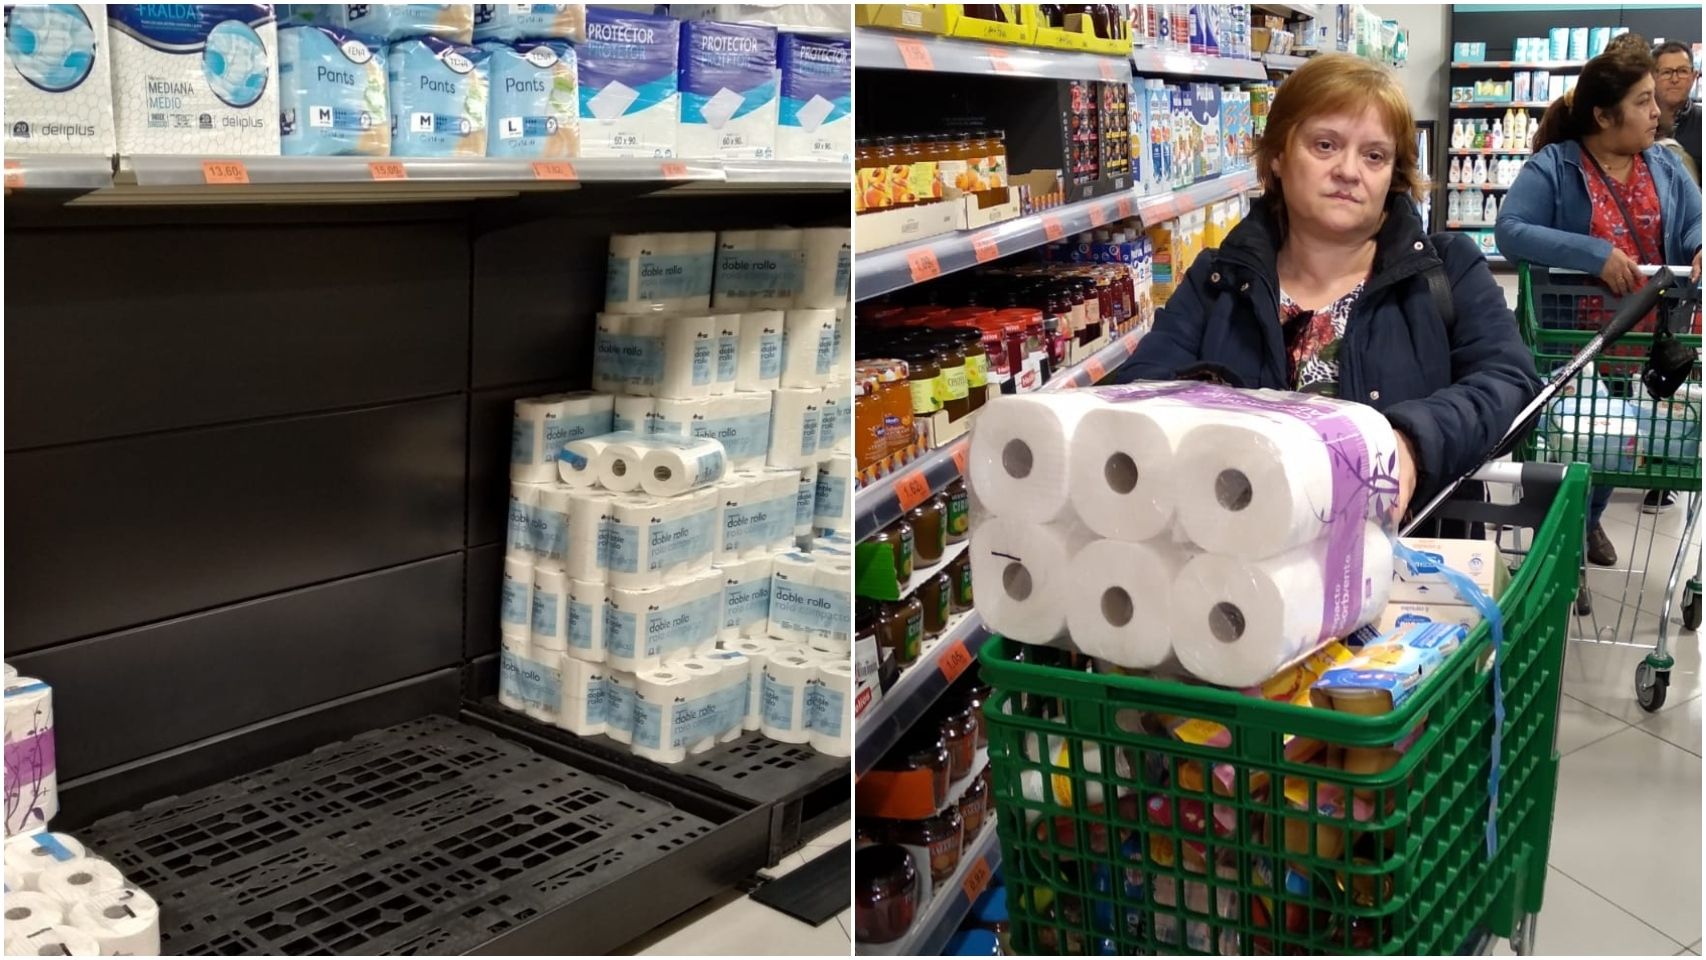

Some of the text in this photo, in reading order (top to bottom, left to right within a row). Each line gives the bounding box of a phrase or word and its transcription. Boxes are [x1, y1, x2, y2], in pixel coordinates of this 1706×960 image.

[588, 23, 654, 44] PROTECTOR
[701, 35, 757, 51] PROTECTOR
[800, 45, 848, 64] PROTECTOR
[317, 65, 355, 86] Pants
[148, 81, 195, 95] MEDIANA
[420, 75, 456, 94] Pants
[505, 78, 545, 92] Pants
[319, 108, 331, 121] M
[420, 115, 431, 126] M
[222, 115, 264, 132] deliplus
[508, 121, 517, 132] L
[641, 264, 683, 277] doble rollo
[722, 259, 777, 270] doble rollo
[568, 425, 585, 437] rollo
[718, 427, 737, 438] rollo
[727, 512, 768, 529] doble rollo
[652, 528, 689, 547] doble rollo
[728, 588, 769, 606] doble rollo
[776, 589, 832, 610] doble rollo
[649, 614, 690, 634] doble rollo
[521, 669, 541, 683] rollo
[674, 703, 717, 725] doble rollo
